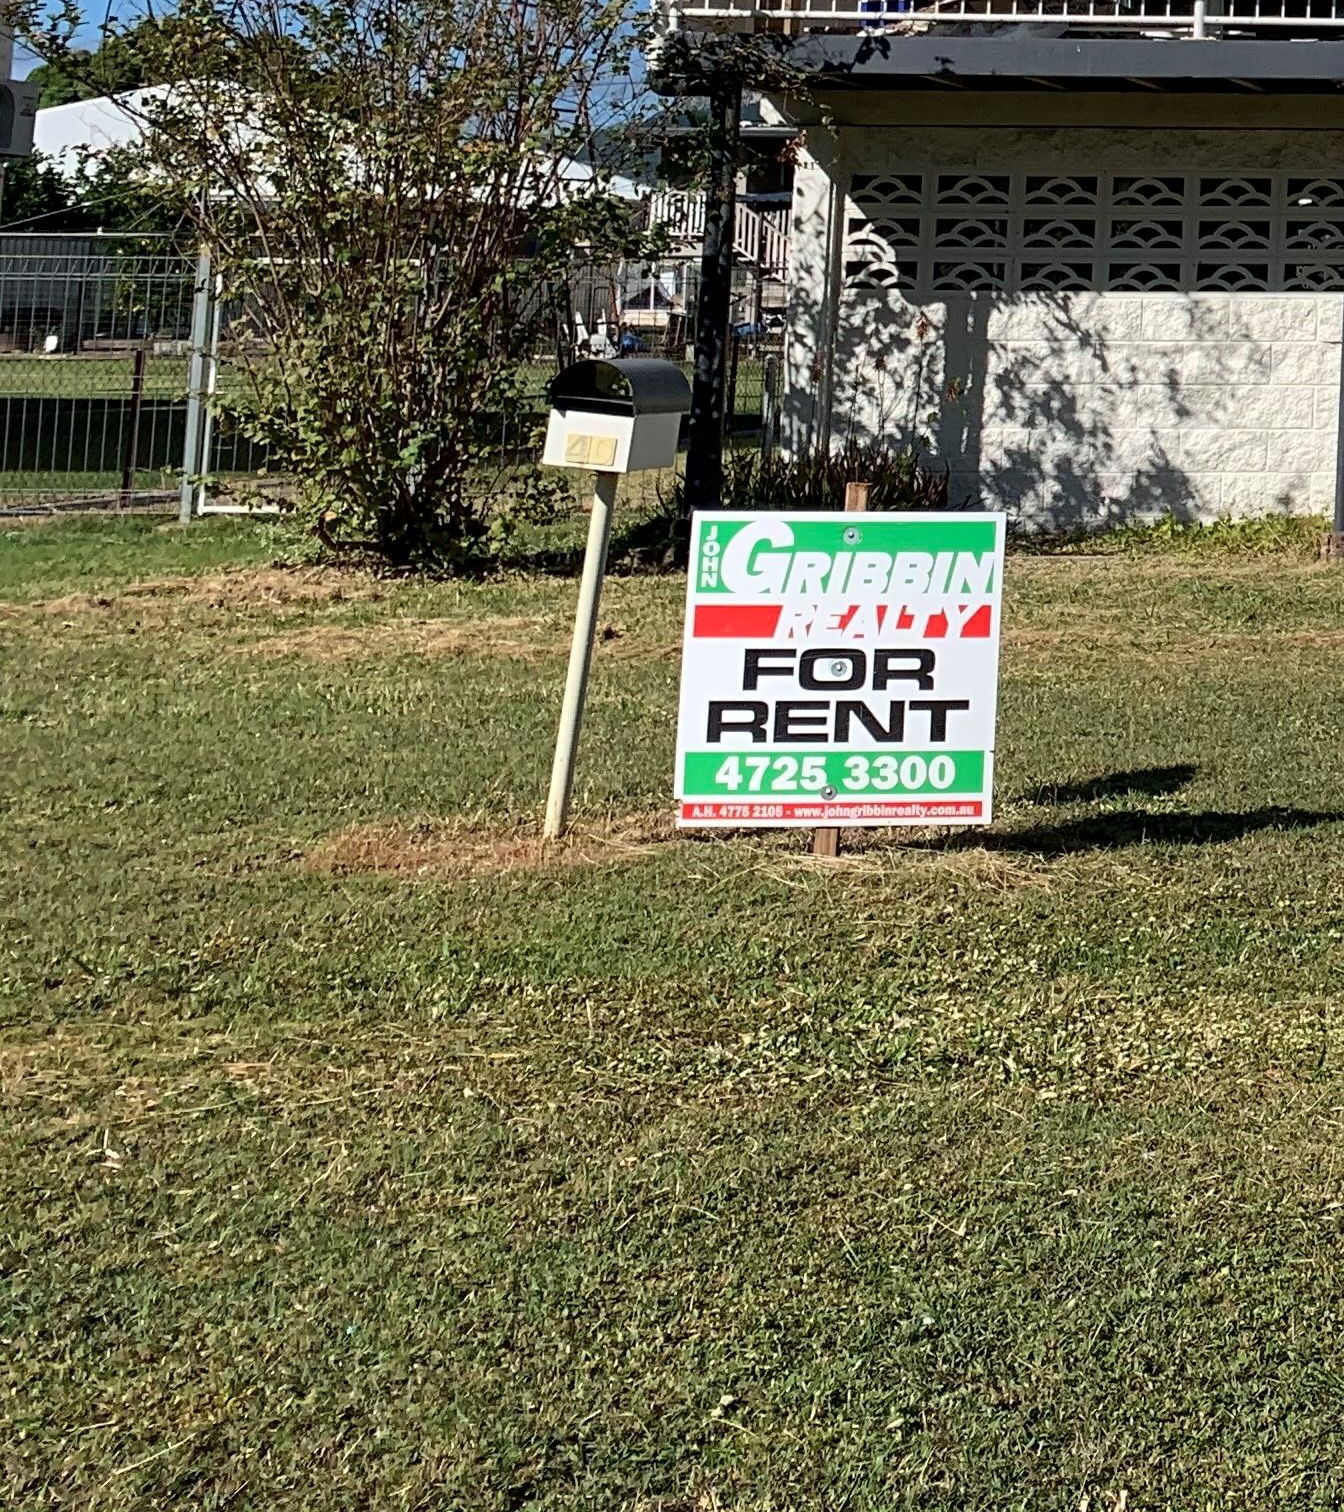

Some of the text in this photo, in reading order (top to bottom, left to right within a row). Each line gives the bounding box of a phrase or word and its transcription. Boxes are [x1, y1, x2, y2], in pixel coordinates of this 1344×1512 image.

[702, 525, 720, 588] JOHN
[721, 520, 996, 593] GRIBBIN
[774, 605, 978, 638] REALTY
[742, 648, 936, 692] FOR
[706, 699, 970, 744] RENT
[715, 755, 956, 792] 4725 3300
[692, 805, 717, 818] A.H.
[752, 804, 783, 818] 2105
